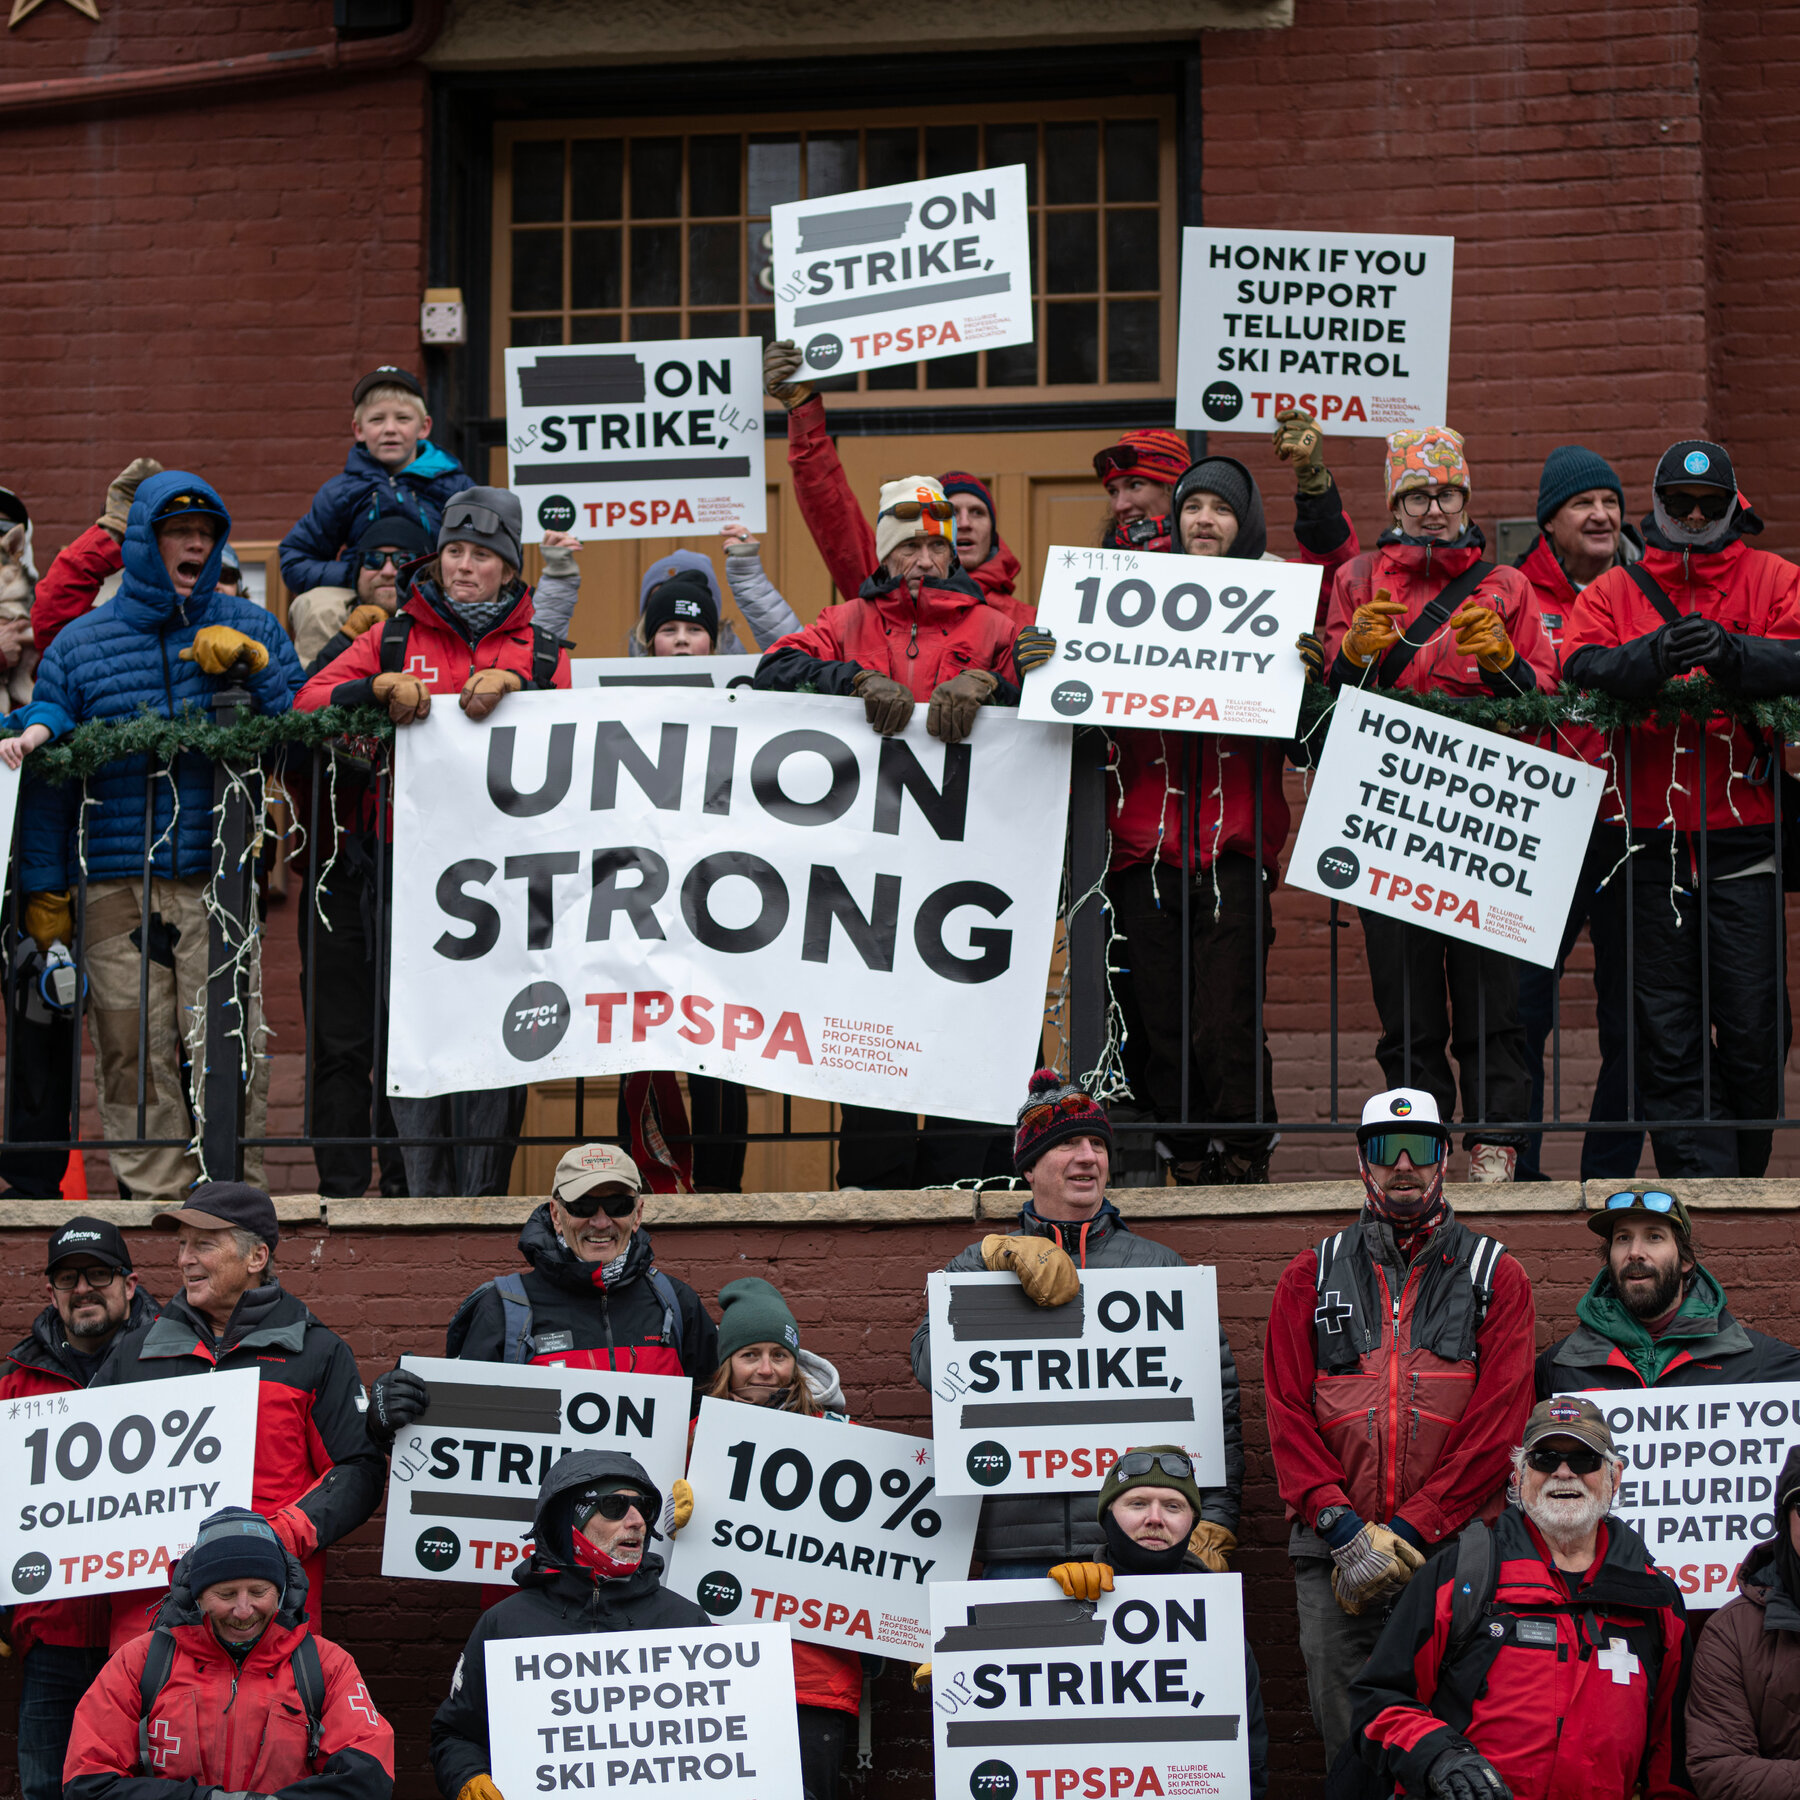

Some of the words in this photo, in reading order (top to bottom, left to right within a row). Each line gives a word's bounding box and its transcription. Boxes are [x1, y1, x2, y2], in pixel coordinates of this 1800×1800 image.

[919, 188, 996, 230] ON
[807, 235, 994, 295] STRIKE,
[1209, 244, 1311, 272] HONK
[1318, 248, 1349, 273] IF
[1354, 249, 1427, 276] YOU
[1237, 279, 1397, 309] SUPPORT
[850, 320, 961, 359] TPSPA
[1223, 313, 1407, 344] TELLURIDE
[654, 359, 732, 398] ON
[1217, 346, 1269, 373] SKI
[1279, 349, 1410, 378] PATROL
[718, 402, 759, 434] ULP
[1250, 392, 1368, 422] TPSPA
[541, 409, 729, 453] STRIKE,
[583, 499, 695, 528] TPSPA
[1074, 576, 1280, 637] 100%
[1063, 639, 1275, 675] SOLIDARITY
[1101, 691, 1220, 722] TPSPA
[1358, 709, 1464, 764] HONK
[1466, 744, 1501, 773] IF
[1505, 754, 1576, 800] YOU
[486, 719, 973, 843] UNION
[1378, 752, 1541, 823] SUPPORT
[1358, 780, 1542, 862] TELLURIDE
[1341, 813, 1398, 852] SKI
[1403, 832, 1533, 897] PATROL
[432, 845, 1015, 985] STRONG
[1367, 866, 1481, 930] TPSPA
[1488, 905, 1524, 920] TELLURIDE
[1482, 925, 1528, 944] ASSOCIATION
[1484, 919, 1500, 928] SKI
[1499, 921, 1521, 936] PATROL
[1486, 911, 1537, 933] PROFESSIONAL
[584, 990, 814, 1066] TPSPA
[821, 1030, 923, 1053] PROFESSIONAL
[823, 1016, 895, 1036] TELLURIDE
[819, 1055, 909, 1078] ASSOCIATION
[820, 1043, 843, 1056] SKI
[844, 1046, 895, 1063] PATROL
[1097, 1289, 1185, 1333] ON
[968, 1346, 1183, 1394] STRIKE,
[566, 1391, 656, 1438] ON
[1600, 1404, 1690, 1435] ONK
[1697, 1402, 1731, 1430] IF
[24, 1405, 222, 1486] 100%
[1018, 1447, 1136, 1480] TPSP
[19, 1481, 221, 1532] SOLIDARITY
[727, 1440, 942, 1538] 100%
[1618, 1475, 1780, 1508] ELLURID
[1657, 1512, 1779, 1544] PATRO
[59, 1545, 171, 1585] TPSPA
[711, 1519, 936, 1585] SOLIDARITY
[750, 1588, 874, 1641] TPSPA
[881, 1612, 919, 1626] TELLURIDE
[1112, 1598, 1208, 1645] ON
[876, 1635, 925, 1649] ASSOCIATION
[878, 1627, 890, 1635] SKI
[890, 1629, 918, 1641] PATROL
[514, 1649, 632, 1682] HONK
[639, 1646, 673, 1674] IF
[678, 1641, 760, 1671] YOU
[550, 1679, 732, 1717] SUPPORT
[972, 1658, 1205, 1710] STRIKE,
[537, 1714, 748, 1754] TELLURIDE
[535, 1762, 596, 1793] SKI
[606, 1752, 757, 1788] PATROL
[1026, 1766, 1165, 1800] TPSPA
[1167, 1764, 1208, 1773] TELLURIDE
[1167, 1771, 1226, 1780] PROFESSIONAL
[1167, 1780, 1181, 1788] SKI
[1181, 1780, 1210, 1788] PATROL
[1168, 1787, 1220, 1796] ASSOCIATION
